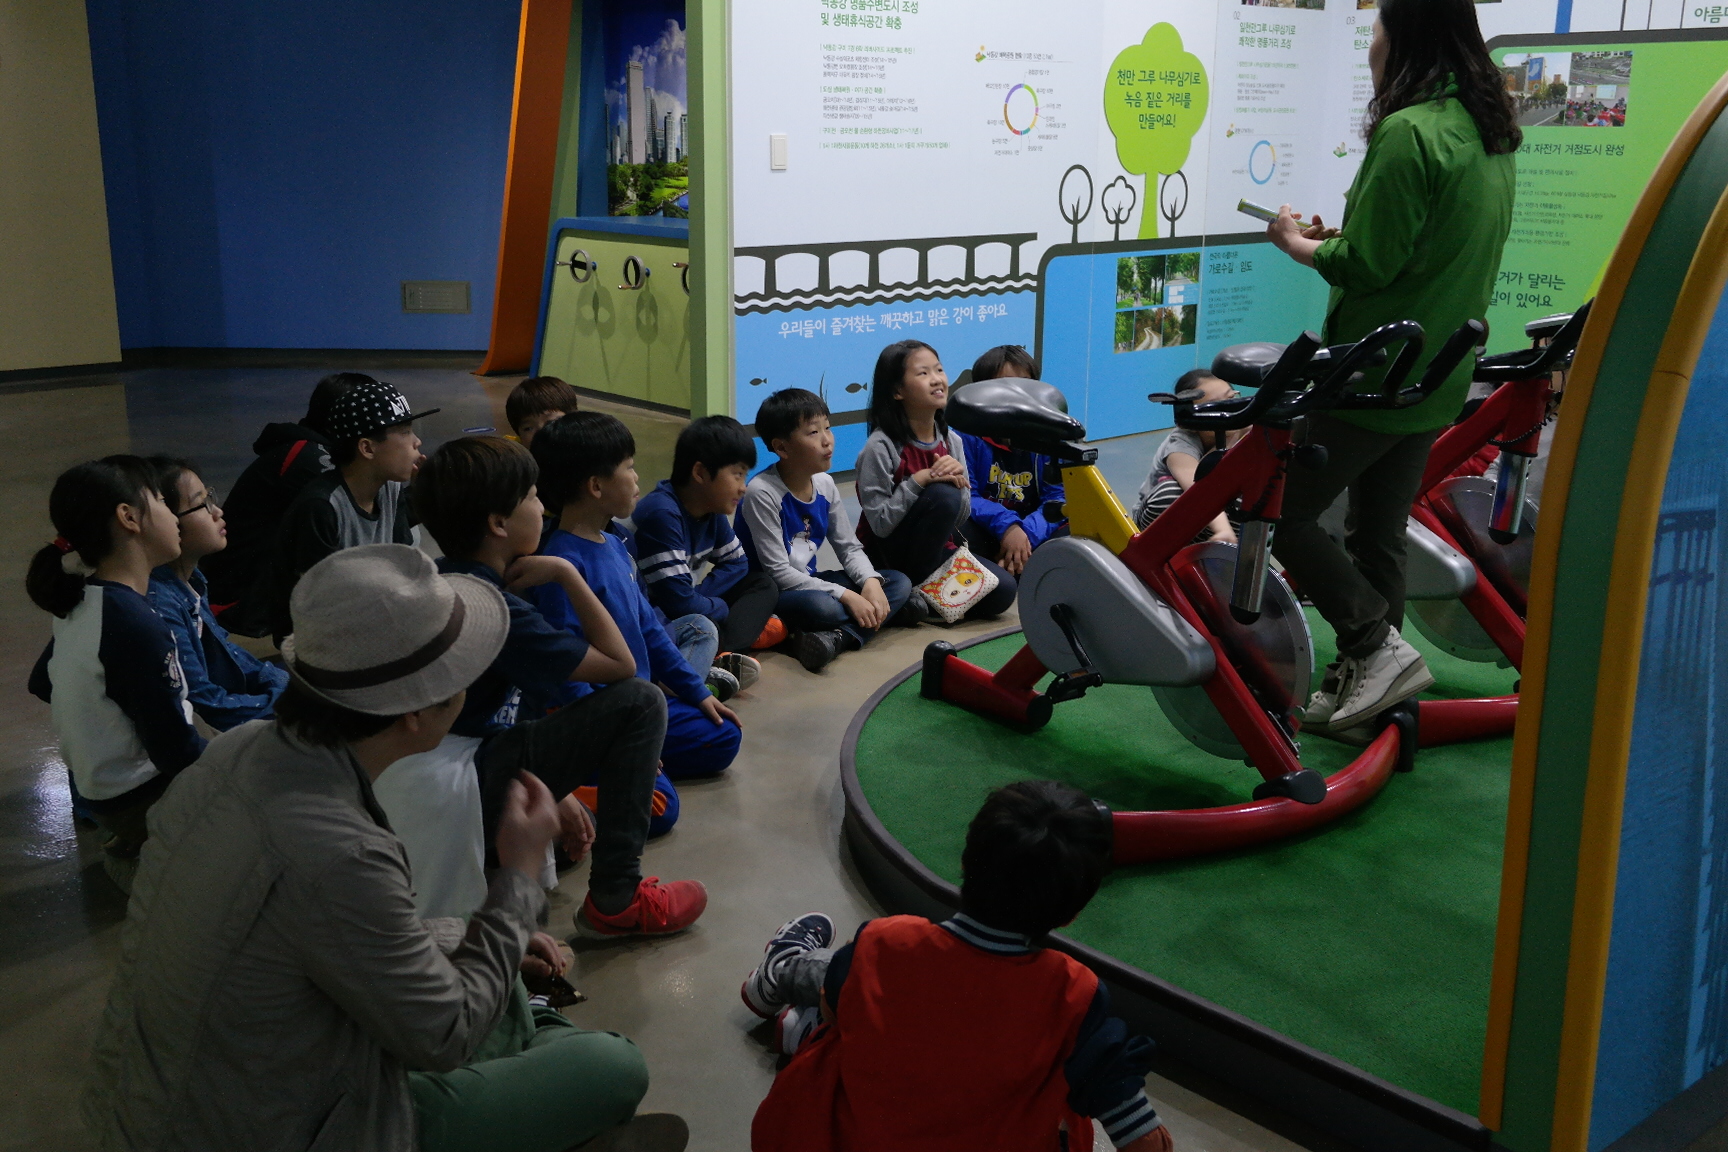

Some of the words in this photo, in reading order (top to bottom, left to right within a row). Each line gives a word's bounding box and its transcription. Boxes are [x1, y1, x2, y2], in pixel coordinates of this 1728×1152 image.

[850, 0, 900, 12] 명품수변도시
[902, 1, 919, 14] 조성
[1694, 6, 1728, 23] 아름
[820, 12, 830, 26] 및
[833, 13, 883, 29] 생태휴식공간
[885, 16, 902, 30] 확충
[1233, 11, 1241, 20] 02
[1346, 16, 1356, 25] 03
[1269, 25, 1296, 36] 나무심기로
[1257, 37, 1279, 49] 명품거리
[1281, 39, 1292, 49] 조성
[1117, 69, 1135, 86] 천만
[1138, 70, 1156, 84] 그루
[1159, 71, 1201, 87] 나무심기로
[1124, 91, 1143, 108] 녹음
[1146, 92, 1163, 108] 짙은
[1166, 92, 1192, 109] 거리를
[1139, 114, 1176, 129] 만들어요!
[1534, 144, 1561, 155] 자전거
[1565, 144, 1602, 155] 거점도시
[1605, 144, 1624, 156] 완성
[1208, 262, 1234, 274] 가로수길
[1241, 261, 1252, 273] 임도
[1528, 273, 1565, 291] 달리는
[1516, 293, 1553, 308] 있어요
[778, 318, 826, 339] 우리들이
[830, 315, 876, 335] 즐겨찾는
[880, 311, 924, 330] 깨끗하고
[928, 308, 949, 327] 맑은
[953, 306, 974, 325] 강이
[977, 303, 1008, 322] 좋아요
